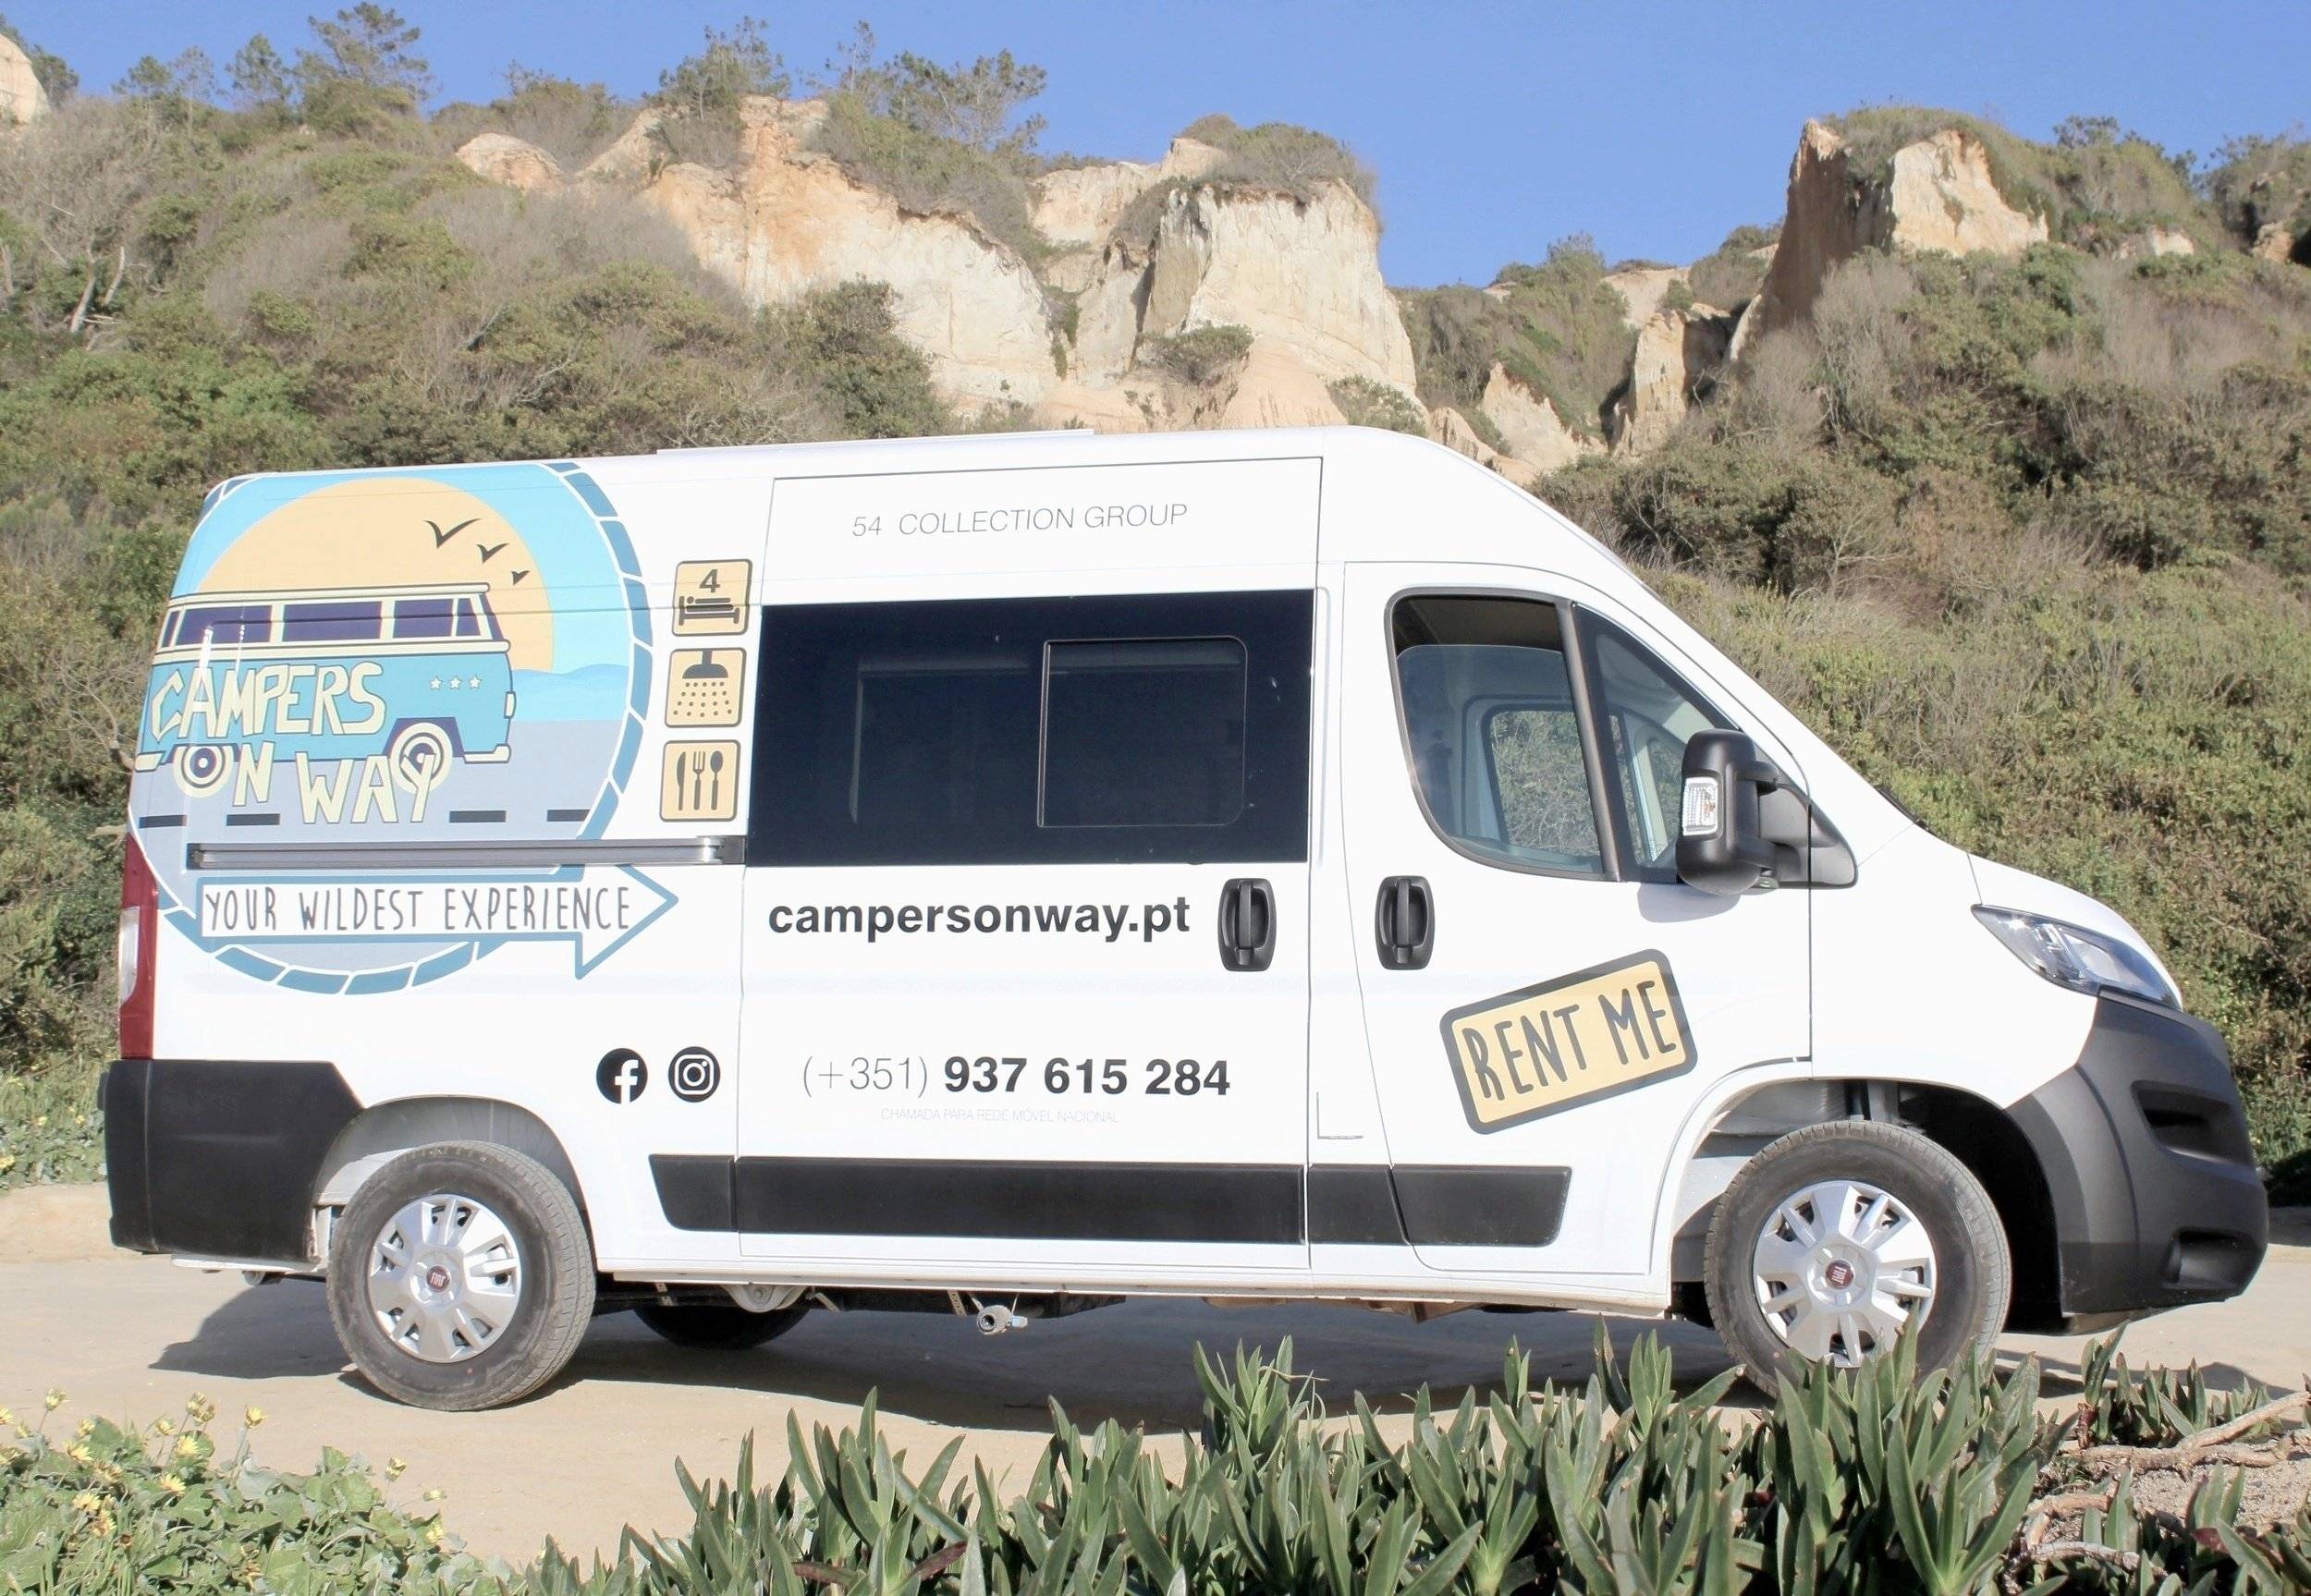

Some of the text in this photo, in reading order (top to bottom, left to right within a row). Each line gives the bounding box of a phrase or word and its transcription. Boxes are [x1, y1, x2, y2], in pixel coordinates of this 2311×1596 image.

[852, 503, 1188, 536] 54 COLLECTION GROUP
[699, 569, 720, 593] 4
[152, 661, 386, 742] CAMPERS
[295, 751, 436, 823] WAY
[205, 885, 630, 931] YOUR WILDEST EXPERIENCE
[768, 896, 1191, 943] campersonway.pt
[1461, 980, 1677, 1103] RENT ME
[802, 1055, 1230, 1099] (+351) 937 615 284
[881, 1108, 941, 1121] CHAMADA
[944, 1109, 974, 1121] PARA
[977, 1109, 1009, 1122] REDE
[1058, 1109, 1120, 1124] NACIONAL
